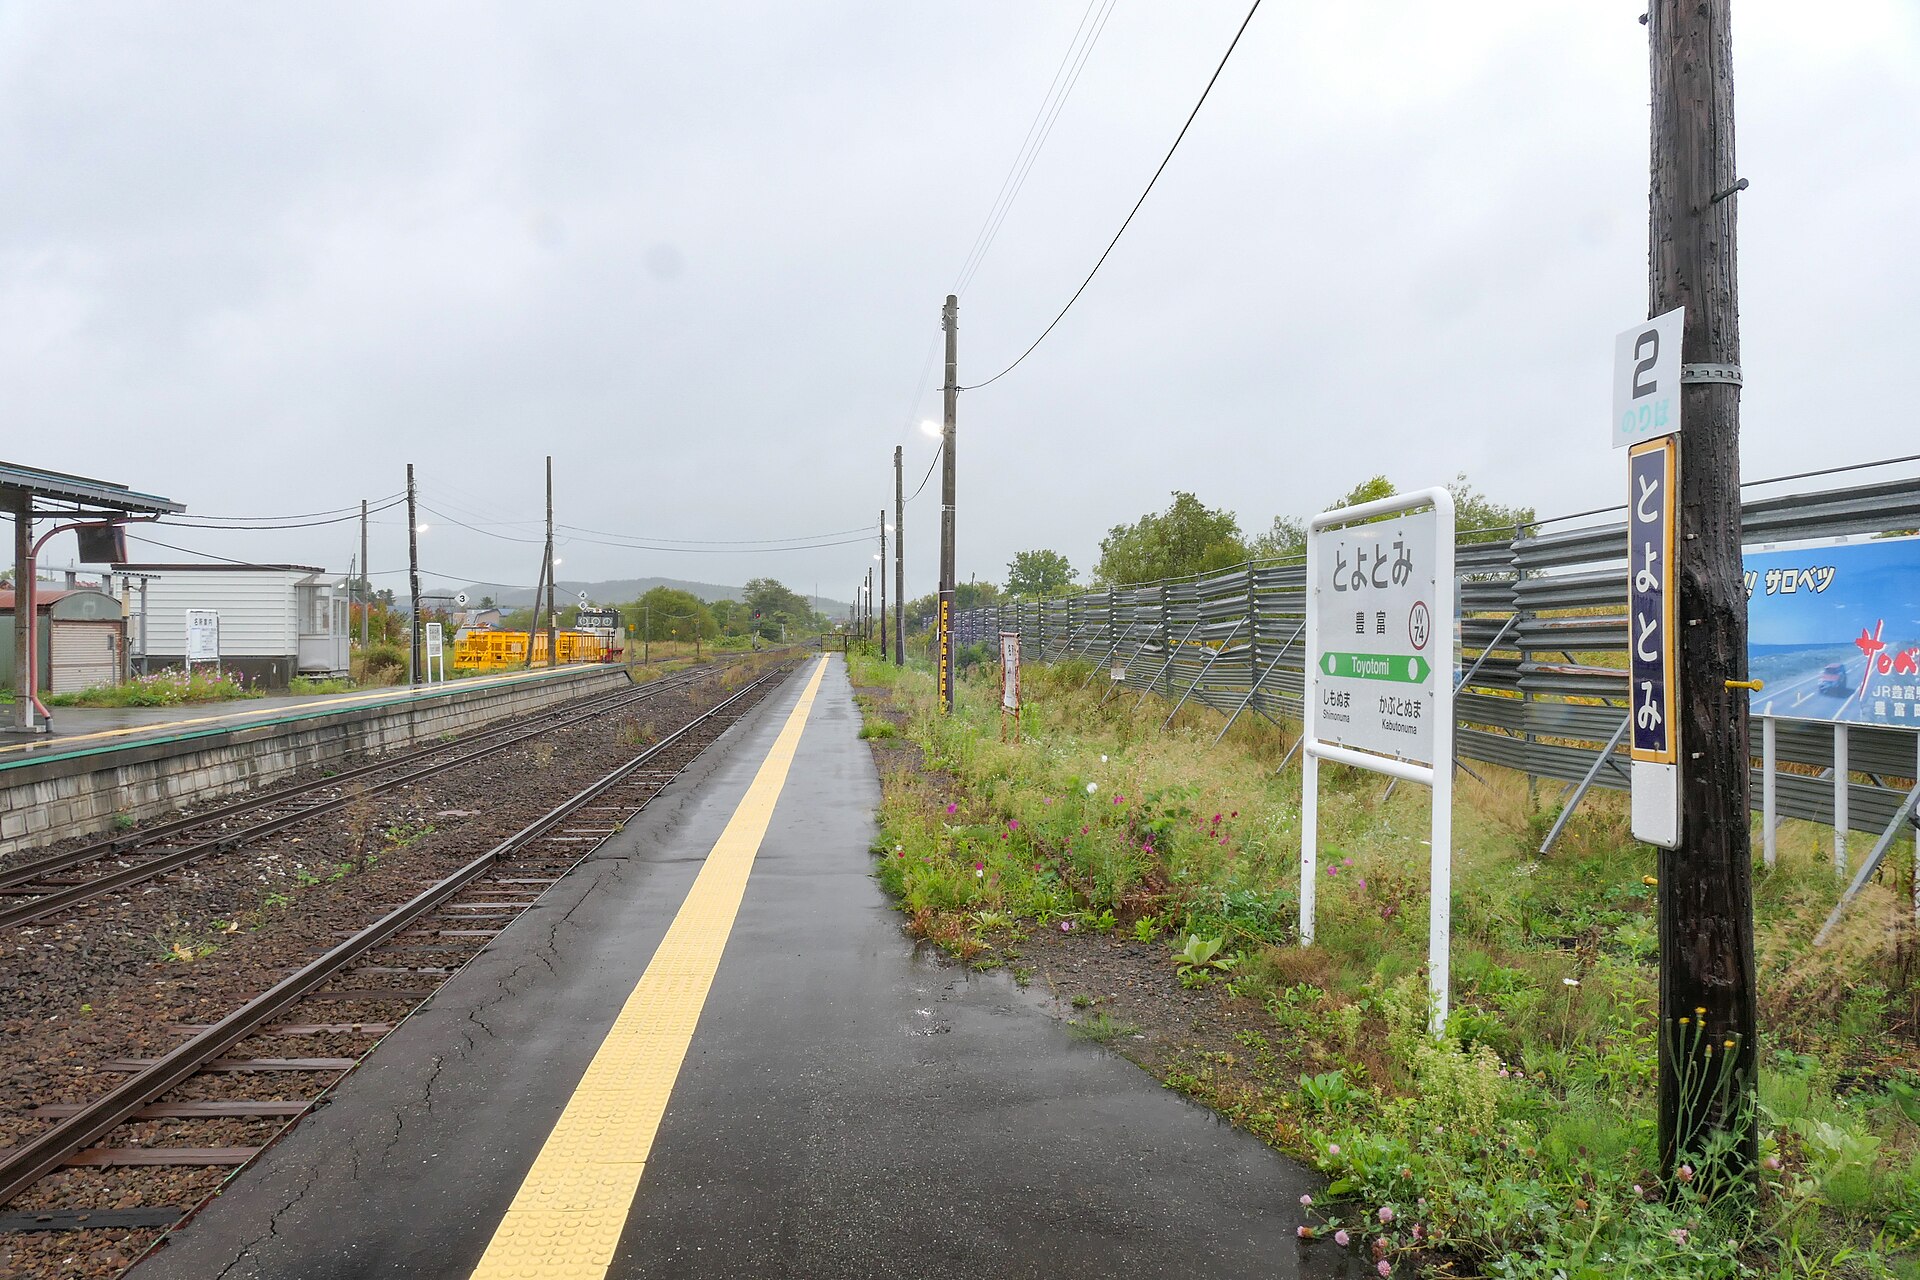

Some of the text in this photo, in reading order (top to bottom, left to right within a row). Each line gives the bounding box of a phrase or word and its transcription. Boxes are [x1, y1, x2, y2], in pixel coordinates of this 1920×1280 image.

[1632, 328, 1660, 400] 2
[1332, 540, 1413, 592] とよとみ
[1765, 566, 1836, 595] サロベツ
[459, 595, 466, 603] 3
[1636, 473, 1662, 731] とよとみ
[1355, 610, 1387, 635] 豊富
[1414, 608, 1424, 625] W
[1413, 625, 1425, 642] 74
[1351, 656, 1390, 677] Toyotomi
[1322, 688, 1351, 708] しもぬま
[1378, 695, 1422, 719] かぶとぬま
[1322, 709, 1351, 723] Shimonuma
[1381, 718, 1418, 735] Kabutonuma
